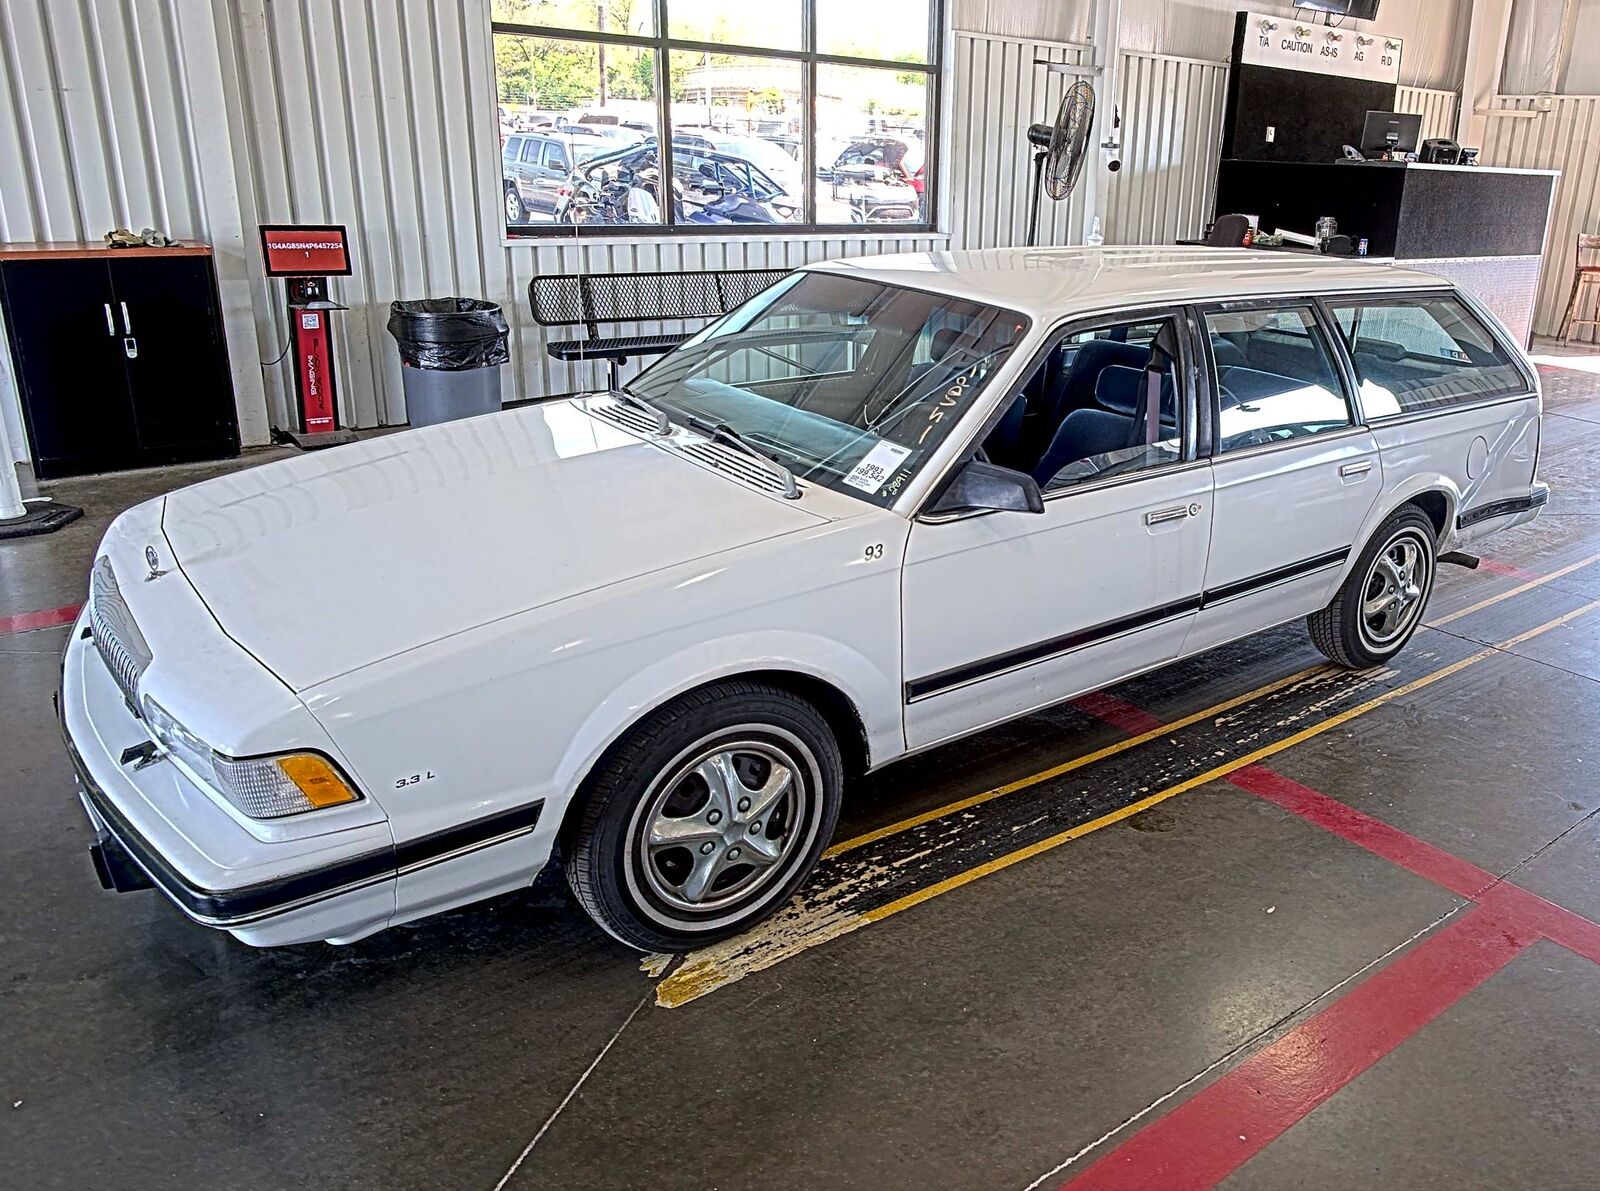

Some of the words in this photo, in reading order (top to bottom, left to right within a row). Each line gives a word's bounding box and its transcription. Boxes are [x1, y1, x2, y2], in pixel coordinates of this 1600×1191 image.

[1281, 39, 1313, 54] CAUTION
[1320, 46, 1338, 58] AS-IS
[1354, 51, 1364, 62] AG
[308, 355, 317, 396] IMAGING
[855, 467, 885, 482] 199,542
[865, 463, 884, 475] 1993
[864, 543, 883, 561] 93
[396, 774, 420, 788] 3.3
[427, 771, 435, 779] L
